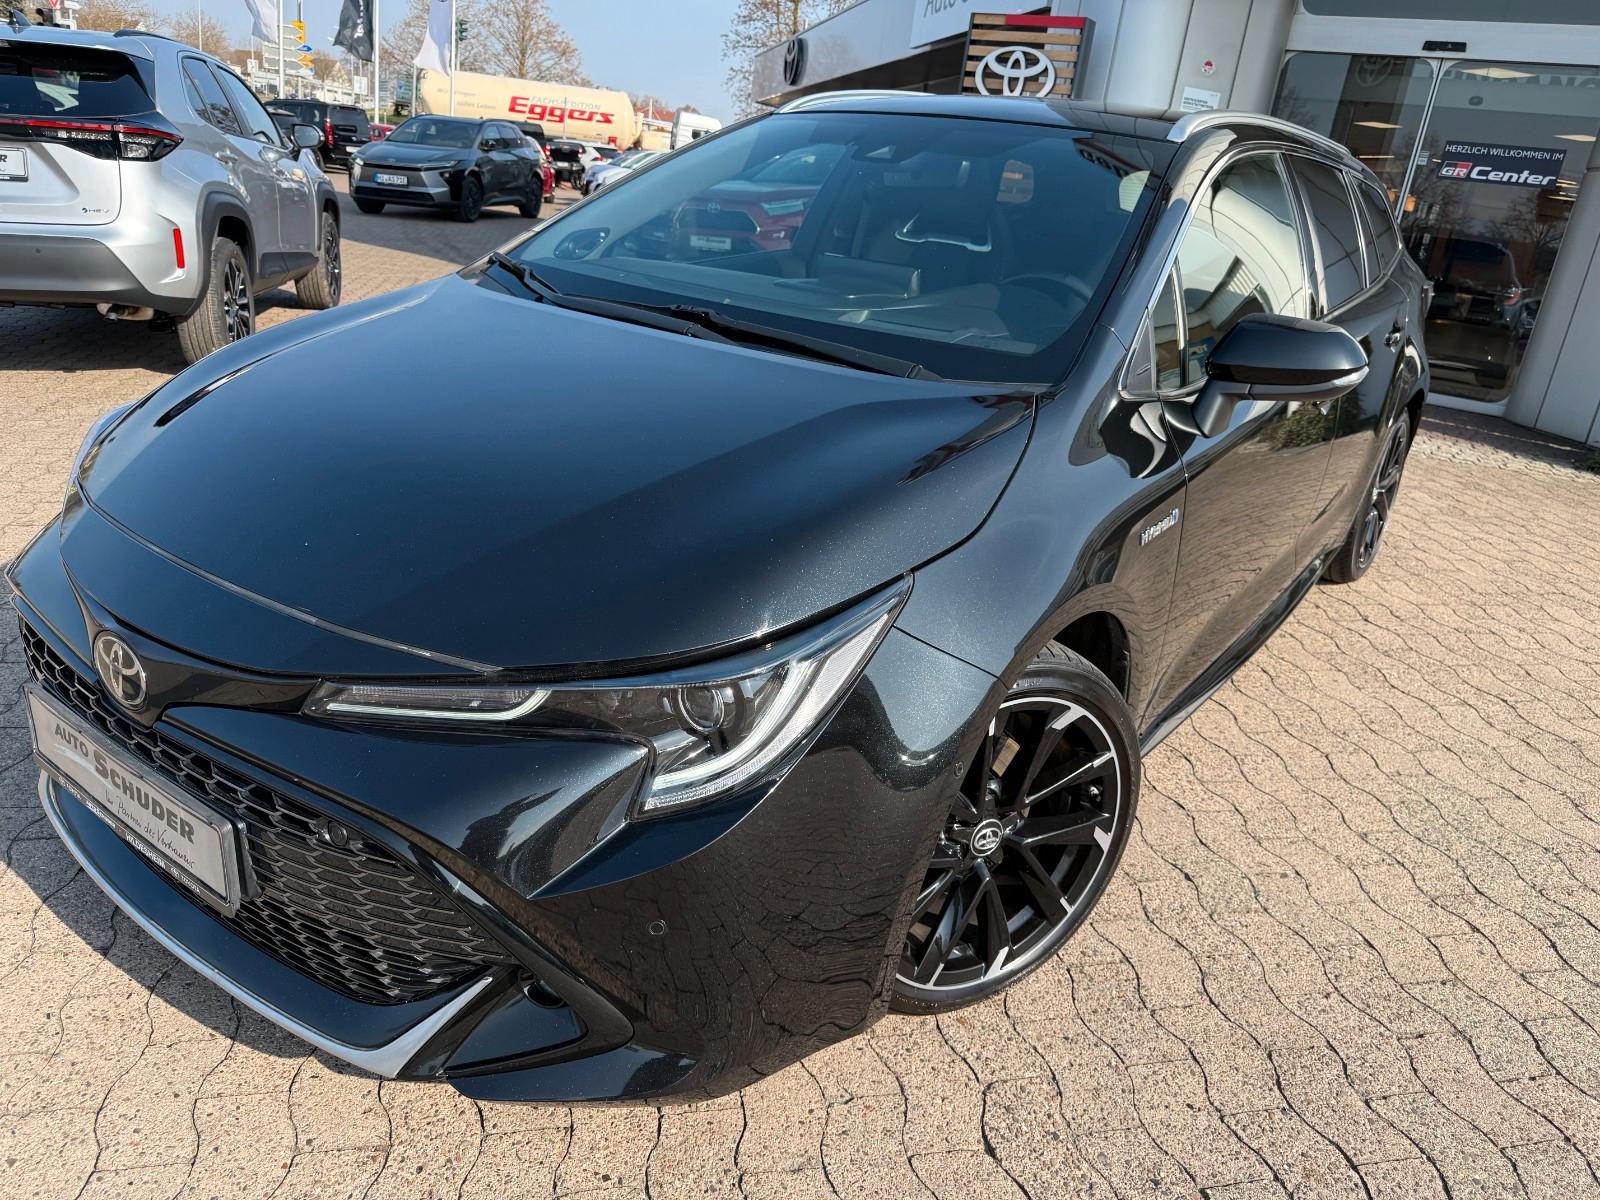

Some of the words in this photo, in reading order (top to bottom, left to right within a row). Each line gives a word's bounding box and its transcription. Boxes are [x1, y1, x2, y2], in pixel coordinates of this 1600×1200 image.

[508, 96, 615, 124] Eggers
[1445, 144, 1488, 155] HERZLICH
[1490, 148, 1550, 160] WILLKOMMEN
[1441, 167, 1467, 176] GR
[1470, 166, 1556, 185] Center
[55, 723, 88, 757] AUTO
[94, 749, 195, 844] SCHUDER
